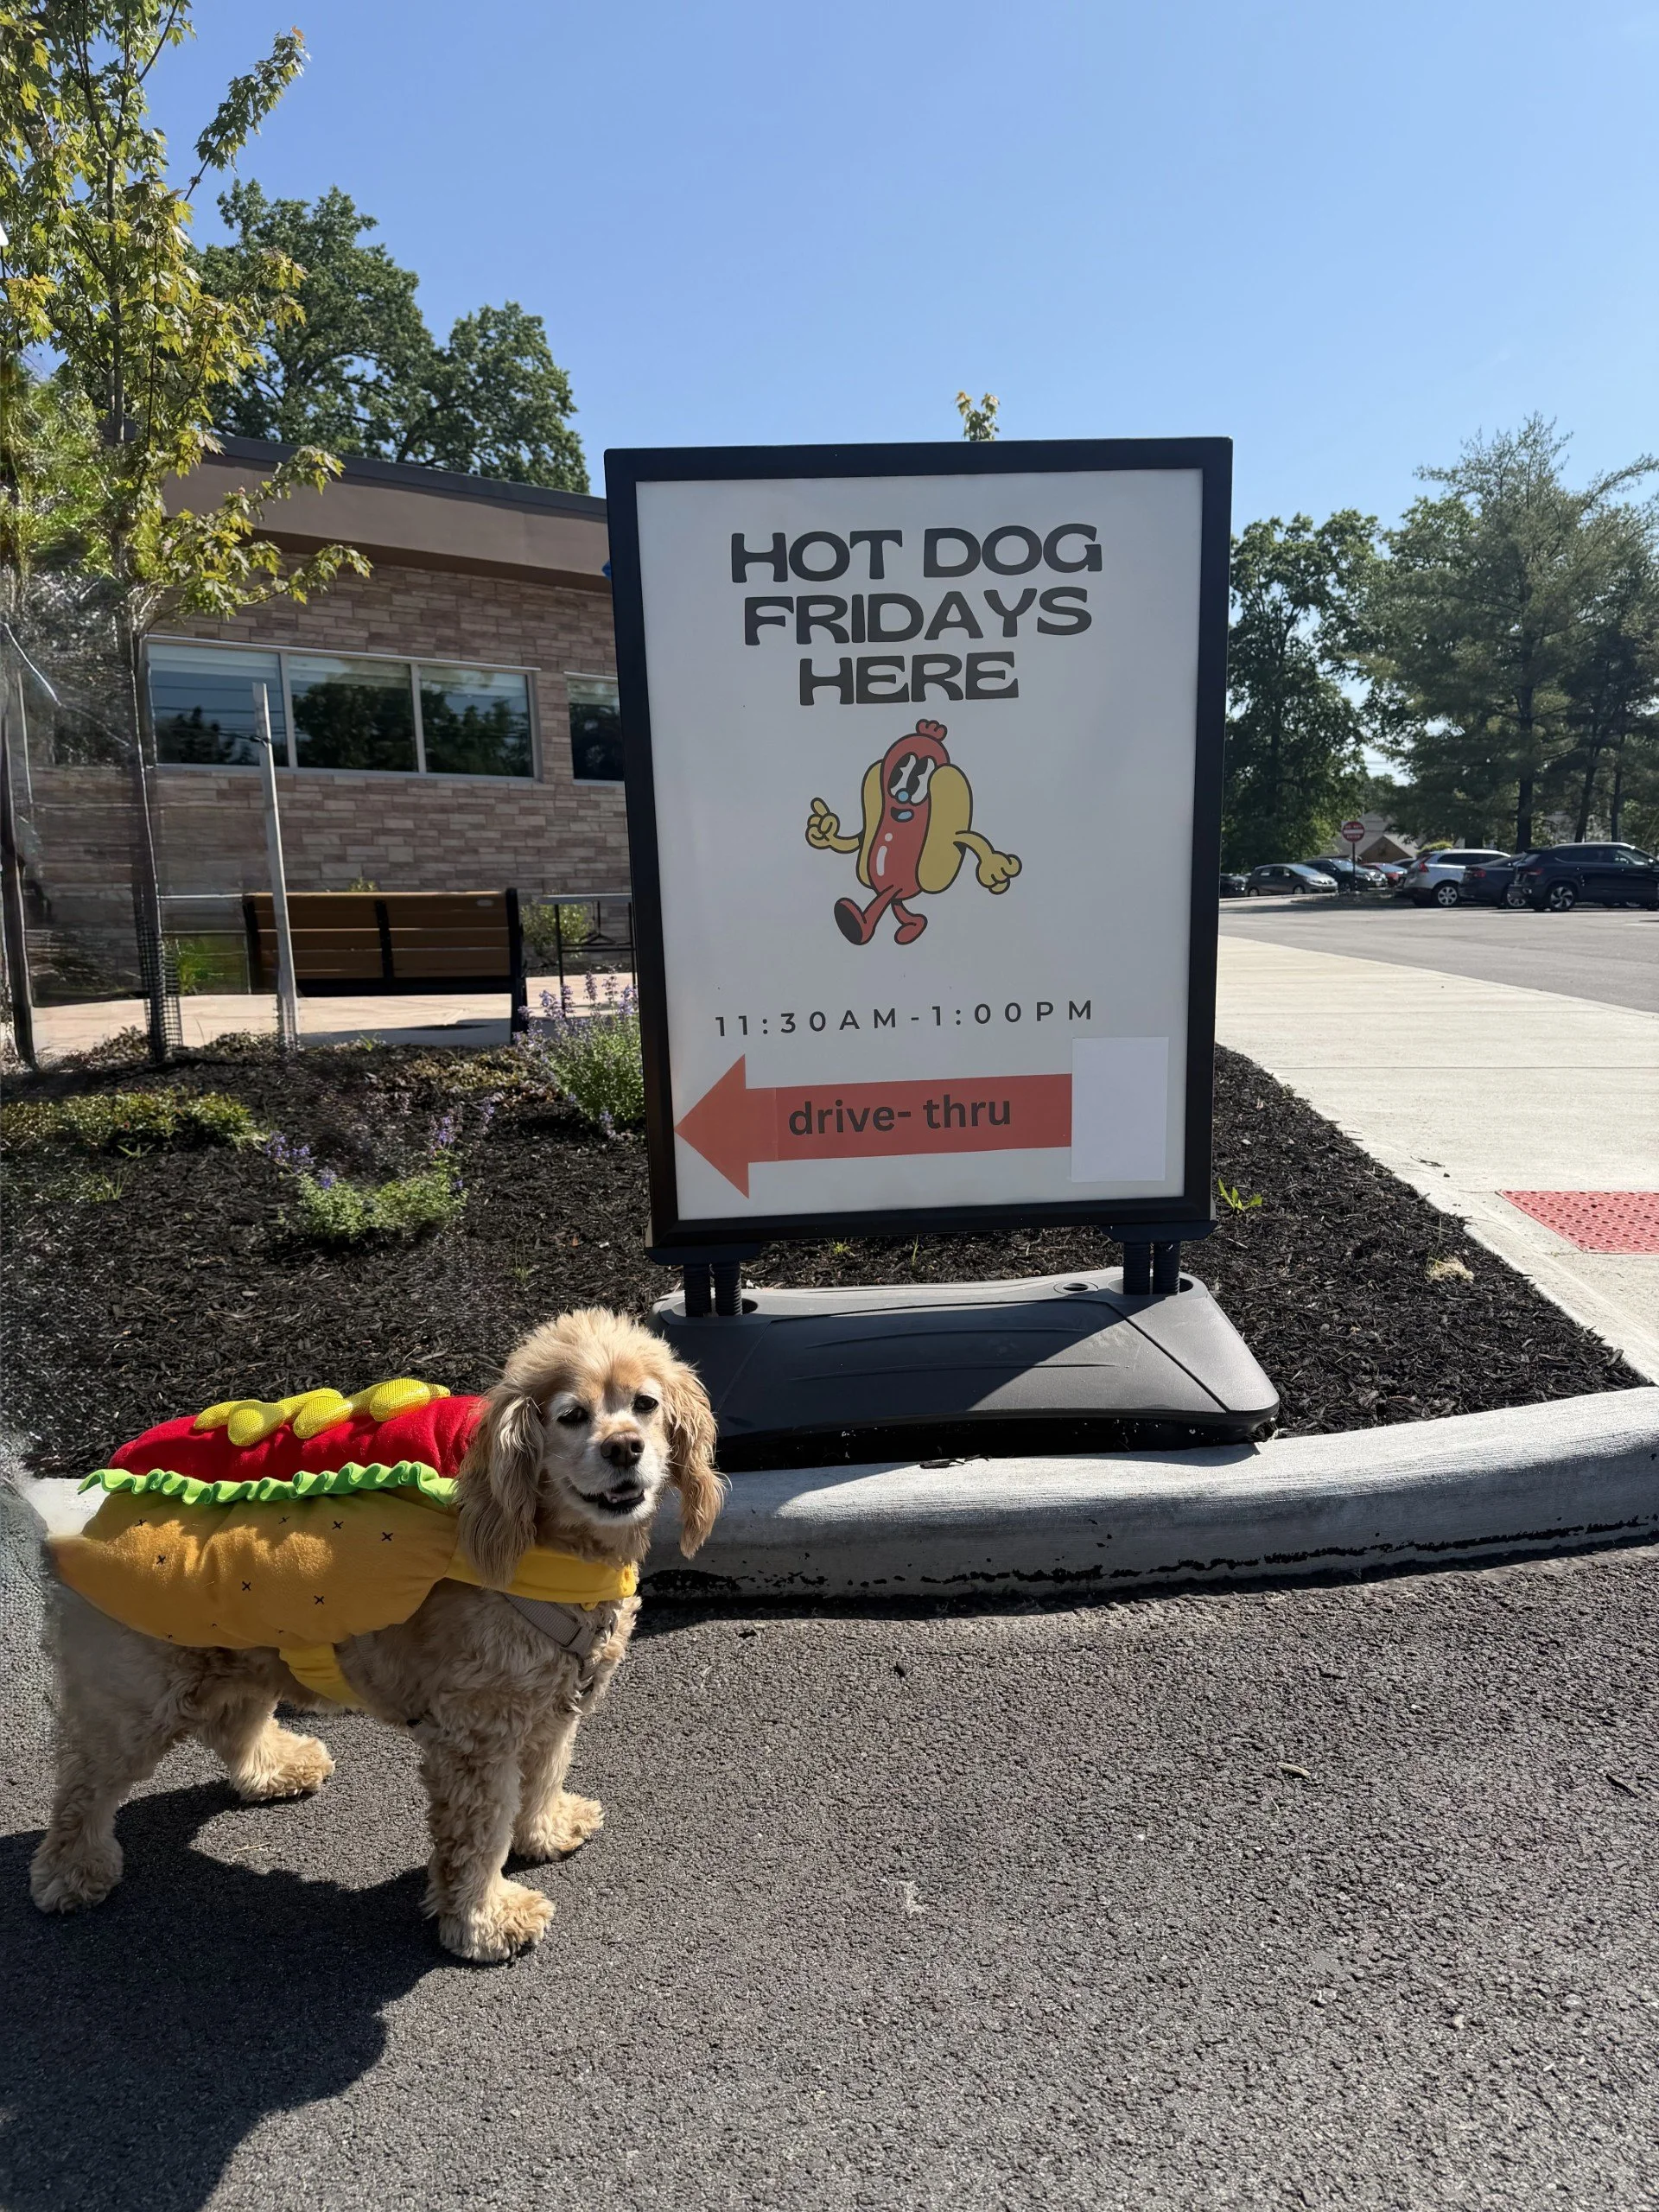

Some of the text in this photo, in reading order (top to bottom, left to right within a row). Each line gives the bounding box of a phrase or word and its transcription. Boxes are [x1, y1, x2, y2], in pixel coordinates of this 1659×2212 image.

[732, 524, 1103, 583] HOT DOG
[745, 587, 1091, 645] FRIDAYS
[800, 652, 1019, 706] HERE
[715, 1001, 1090, 1036] 11:30AM-1:00PM
[789, 1095, 1011, 1136] drive- thru
